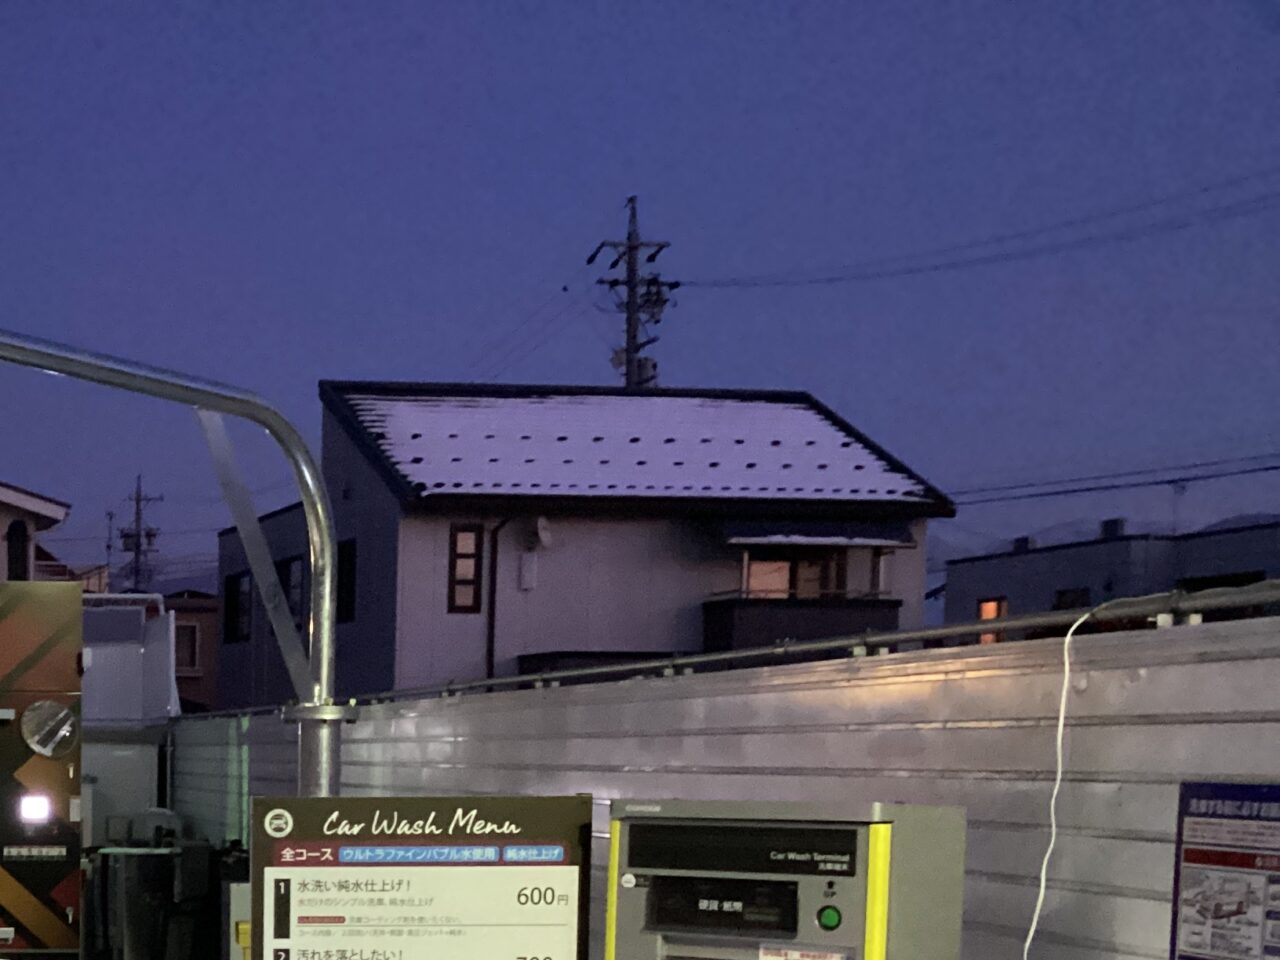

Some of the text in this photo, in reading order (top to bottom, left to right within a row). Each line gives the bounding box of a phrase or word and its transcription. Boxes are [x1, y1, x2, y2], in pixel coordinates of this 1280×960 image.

[323, 809, 521, 836] Car Wash Menu
[281, 847, 333, 861] 全コース
[278, 881, 286, 894] 1
[517, 887, 569, 906] 600円
